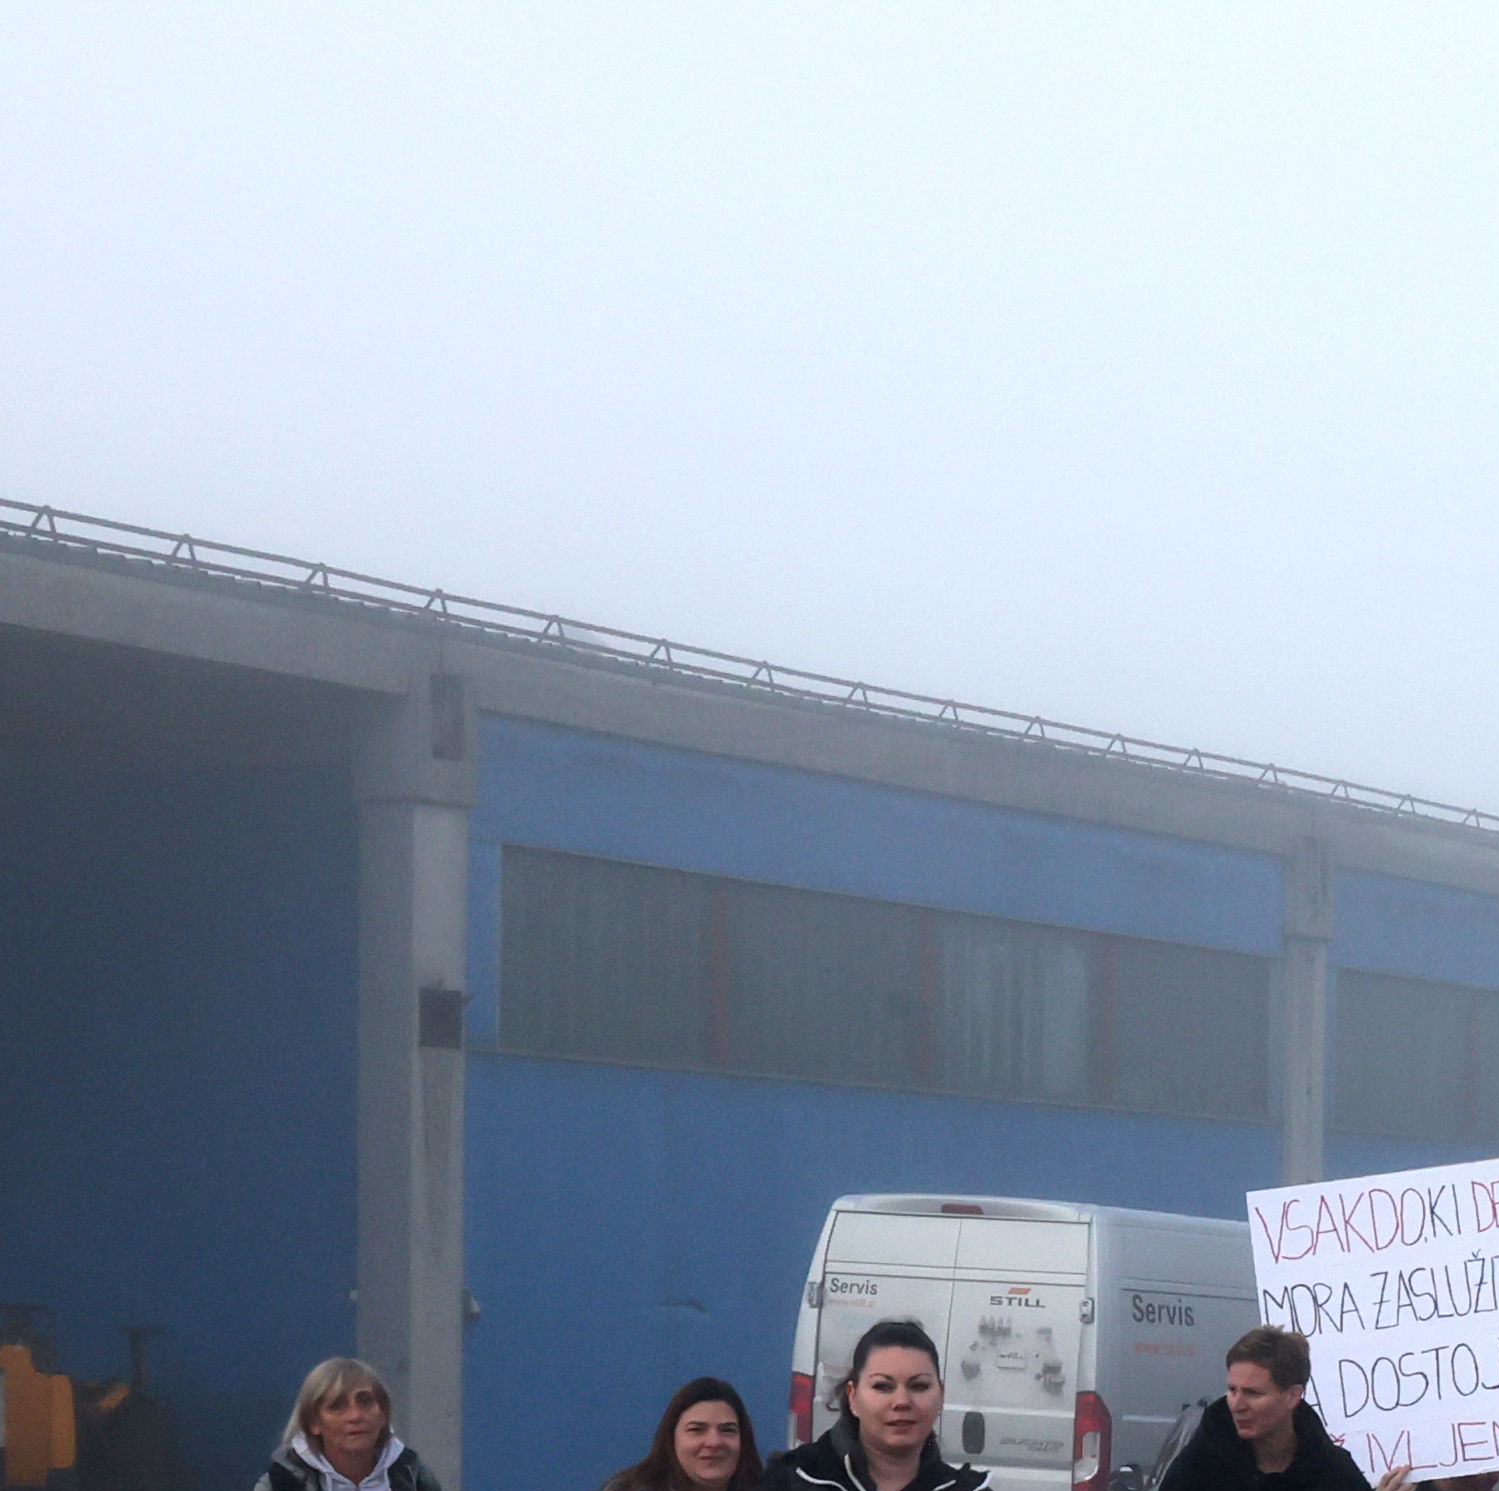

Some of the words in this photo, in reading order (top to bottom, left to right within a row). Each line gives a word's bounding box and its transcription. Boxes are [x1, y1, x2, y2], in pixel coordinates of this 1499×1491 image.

[1428, 1184, 1462, 1238] KI
[829, 1277, 878, 1296] Servis
[989, 1295, 1047, 1309] STILL
[1131, 1294, 1195, 1327] Servis
[1263, 1280, 1366, 1339] MORA
